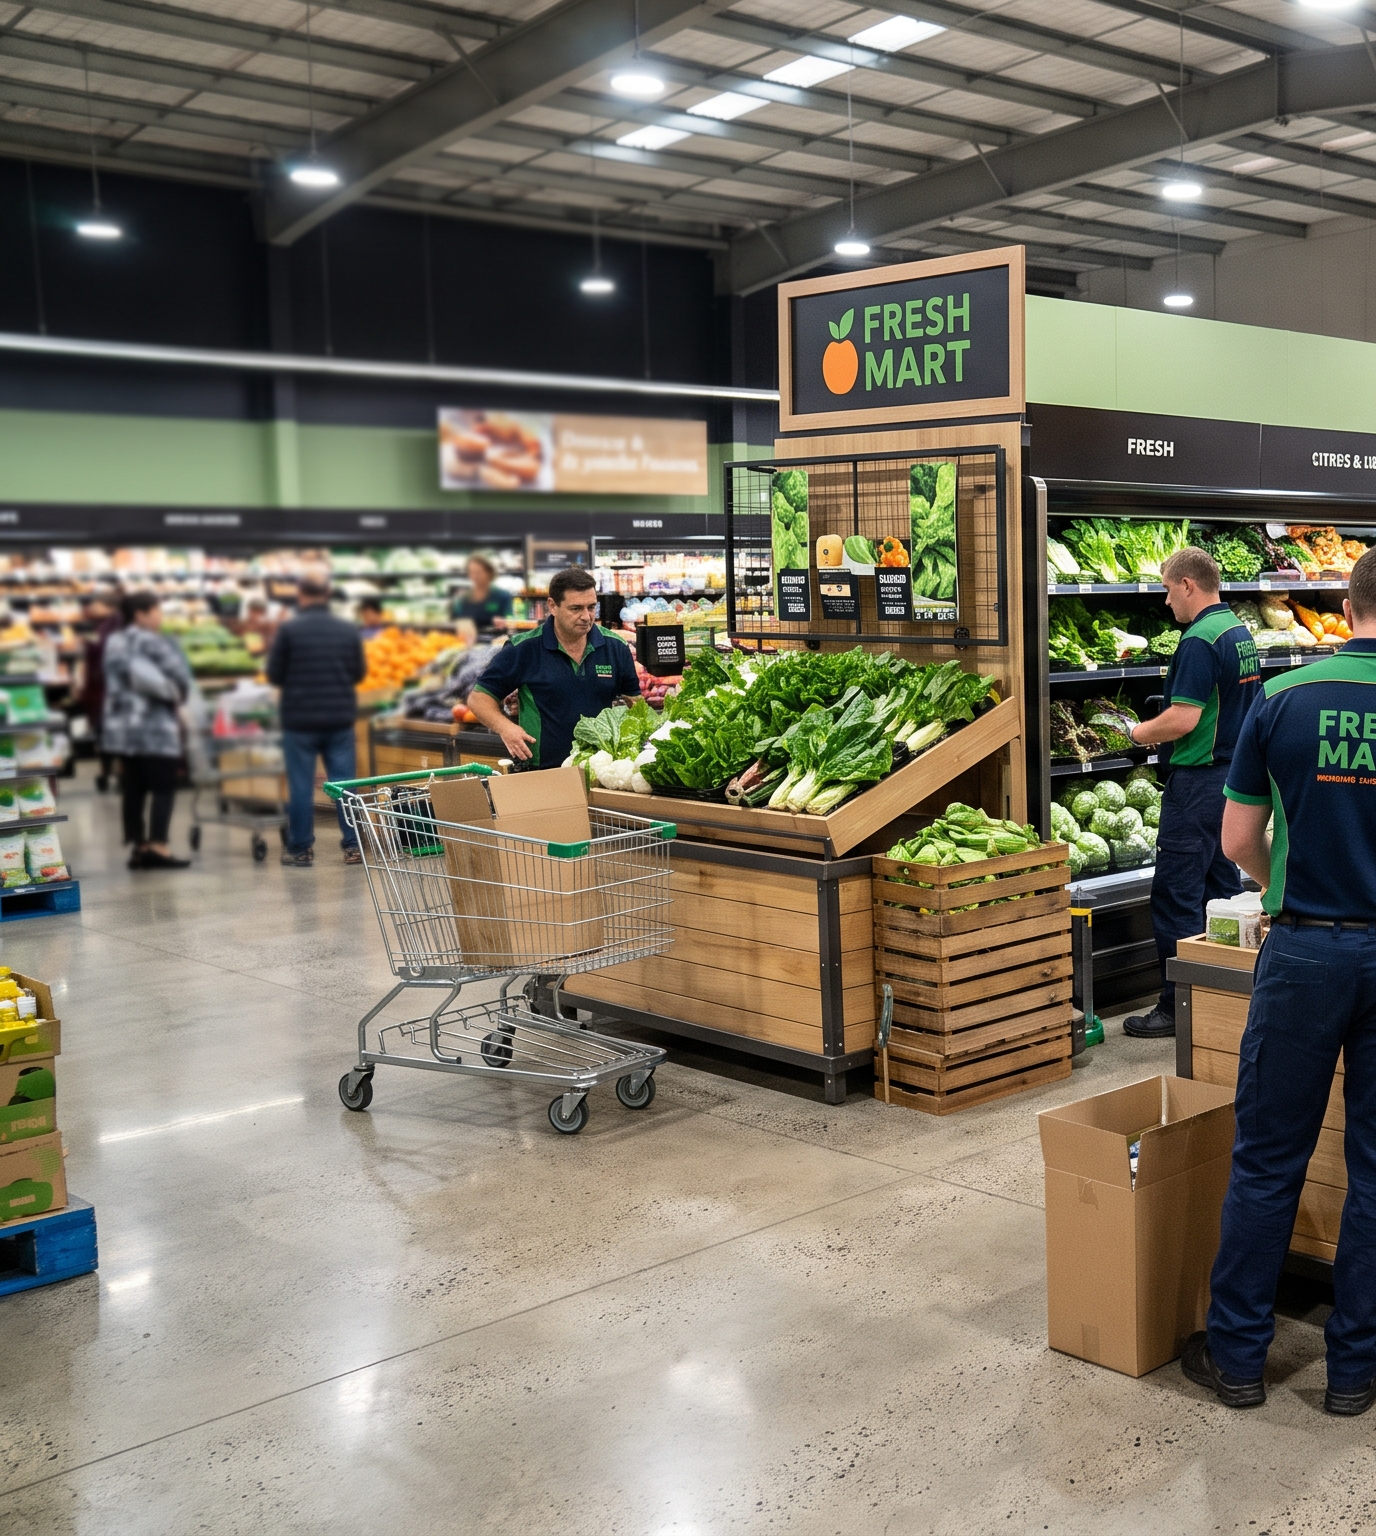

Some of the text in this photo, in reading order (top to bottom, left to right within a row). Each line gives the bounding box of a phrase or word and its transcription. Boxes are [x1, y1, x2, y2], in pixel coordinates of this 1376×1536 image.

[864, 292, 970, 344] FRESH
[865, 339, 971, 391] MART
[1127, 438, 1174, 457] FRESH
[1353, 454, 1363, 469] &
